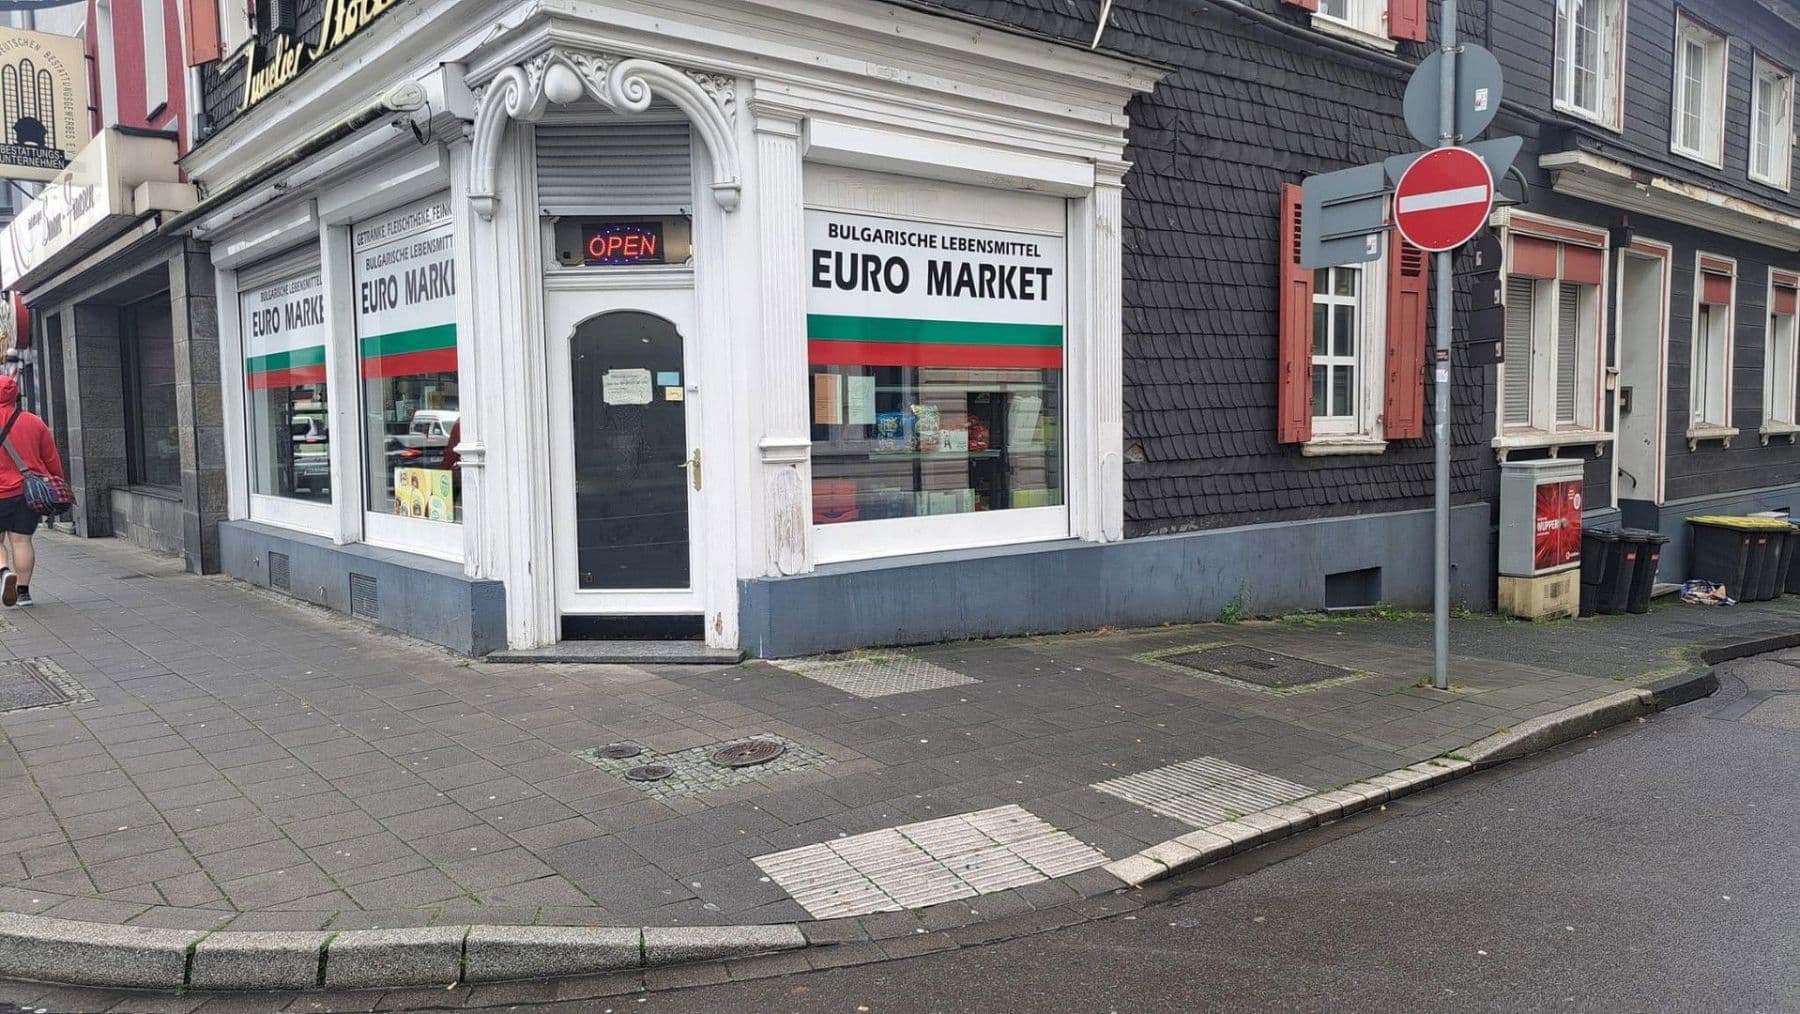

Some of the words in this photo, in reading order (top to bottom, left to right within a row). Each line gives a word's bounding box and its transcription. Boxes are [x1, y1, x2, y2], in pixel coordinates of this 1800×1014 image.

[236, 33, 304, 113] Juwelier
[0, 153, 65, 168] UNTERNEHMEN
[589, 235, 656, 256] OPEN
[828, 223, 937, 249] BULGARISCHE
[941, 236, 1041, 257] LEBENSMITTEL
[366, 247, 409, 271] BULGARISCHE
[812, 249, 910, 294] EURO
[927, 260, 1053, 301] MARKET
[362, 275, 398, 314] EURO
[253, 306, 280, 337] EURO
[285, 294, 325, 331] MARKE
